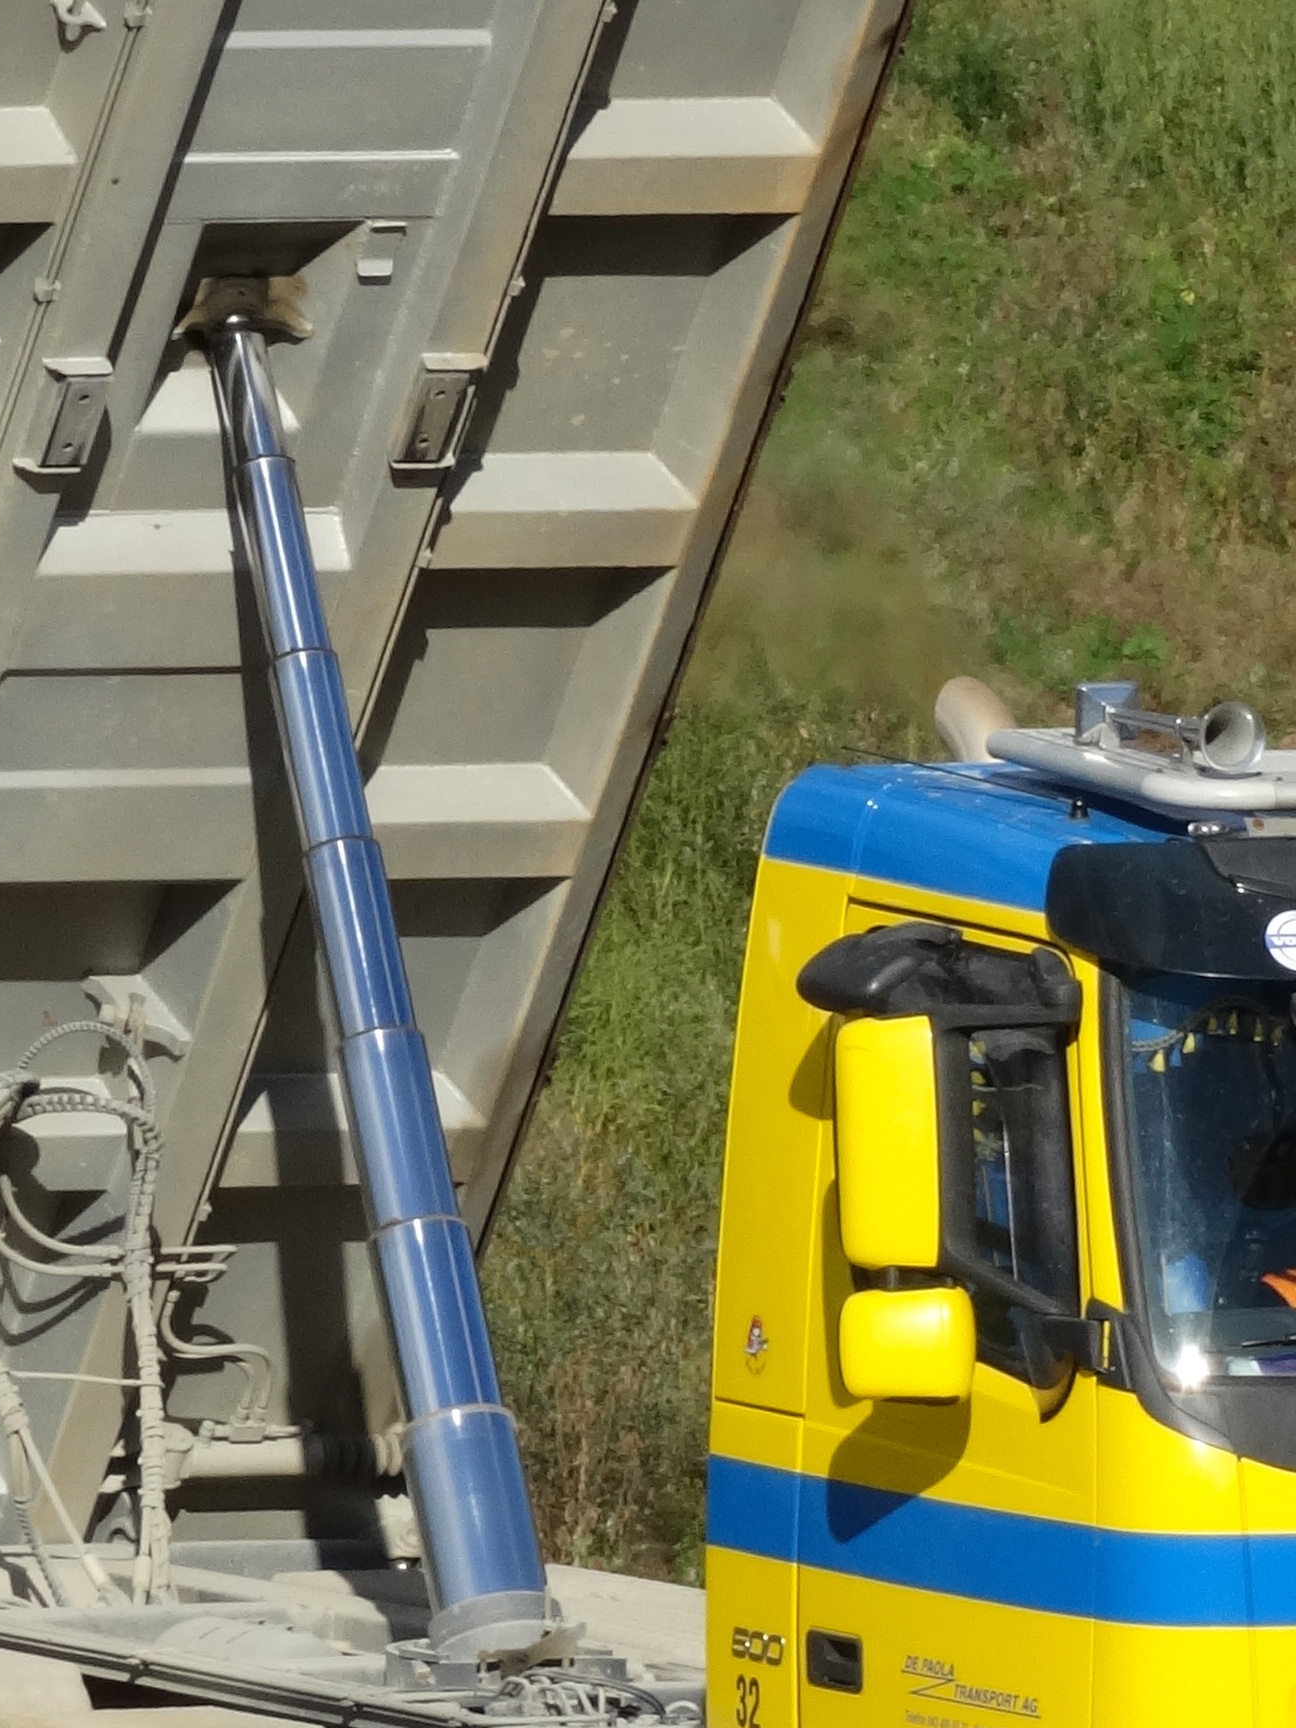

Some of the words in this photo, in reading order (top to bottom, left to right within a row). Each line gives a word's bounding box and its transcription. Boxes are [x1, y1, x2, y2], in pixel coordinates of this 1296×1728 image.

[731, 1626, 785, 1667] 500
[904, 1654, 920, 1671] DE
[921, 1658, 955, 1678] PAOLA
[953, 1683, 1020, 1710] TRANSPORT
[1021, 1695, 1039, 1713] AG
